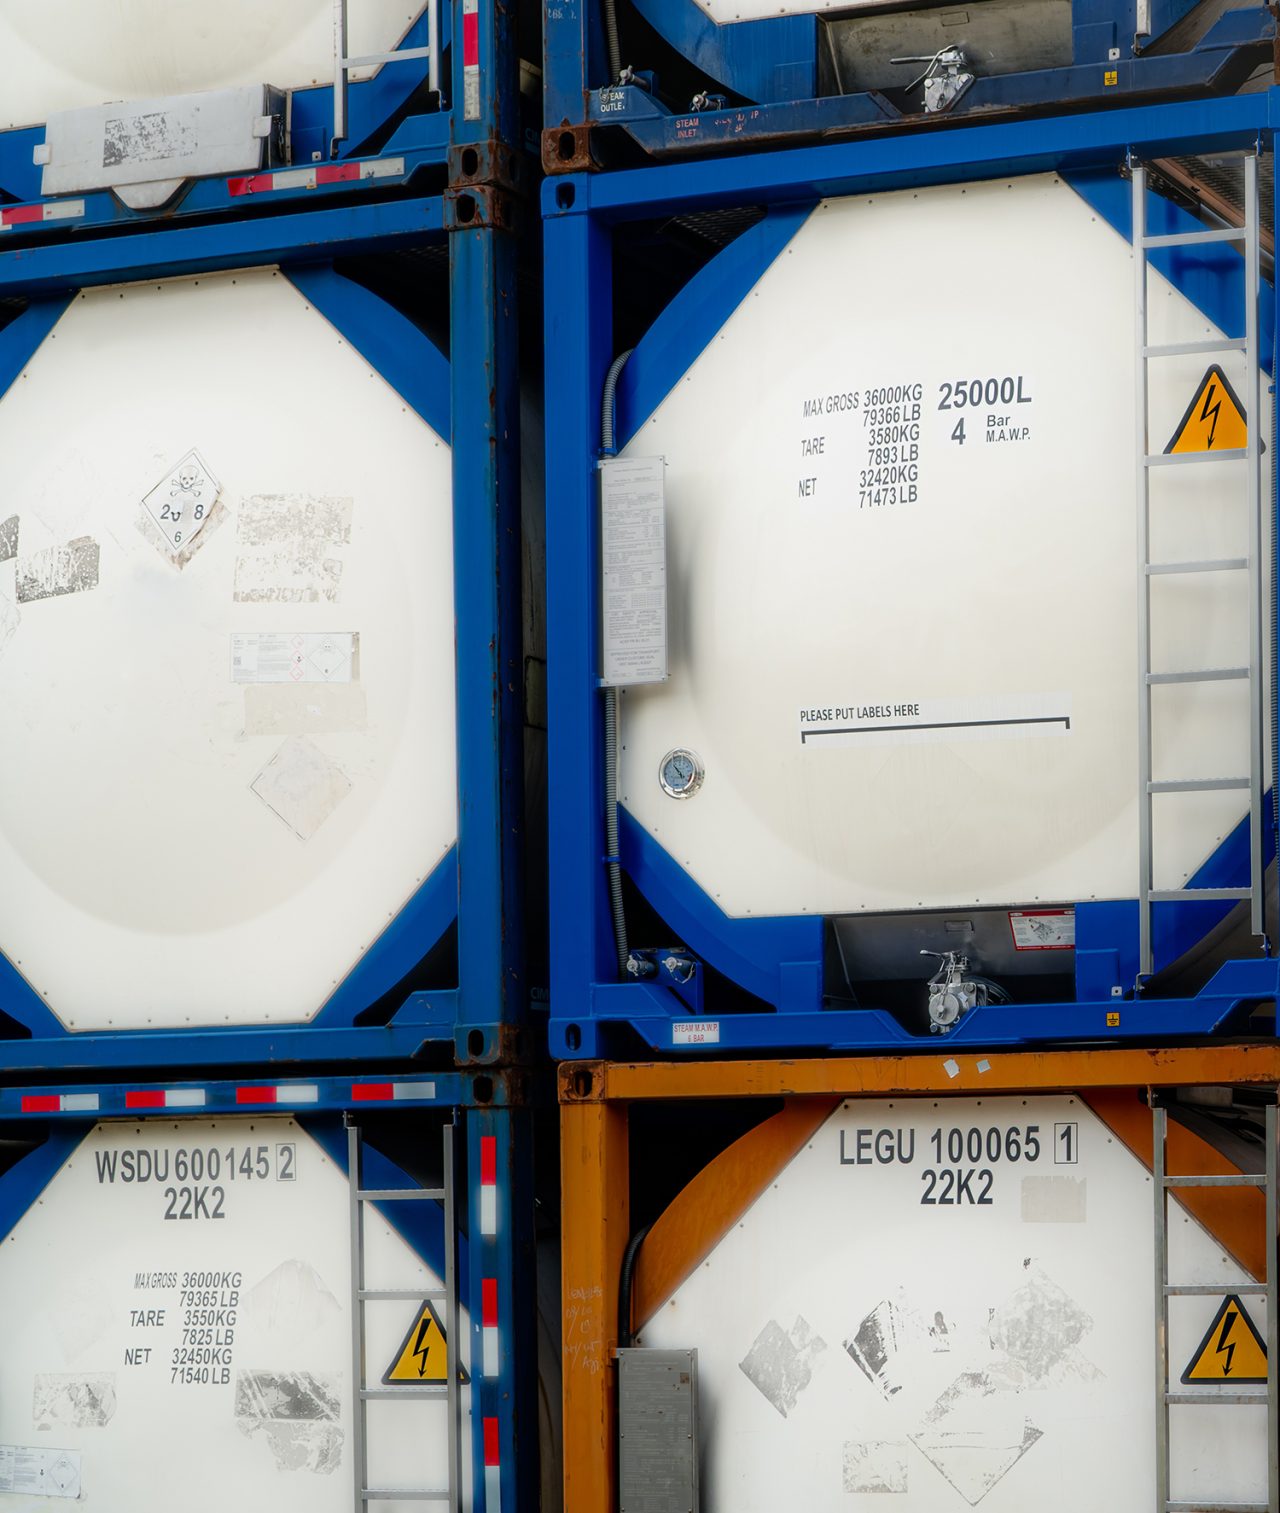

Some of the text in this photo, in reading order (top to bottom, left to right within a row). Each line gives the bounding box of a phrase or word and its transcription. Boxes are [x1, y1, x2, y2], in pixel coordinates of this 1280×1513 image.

[675, 118, 699, 129] STEAM
[677, 129, 697, 139] INLET
[803, 383, 923, 417] MAX GROSS 36000KG
[937, 375, 1032, 411] 25000L
[863, 403, 921, 427] 79366 LB
[950, 414, 1011, 446] 4 Bar
[800, 422, 920, 457] TARE 3580KG
[986, 427, 1031, 443] M.A.W.P.
[867, 443, 919, 467] 7893 LB
[798, 463, 919, 497] NET 32420KG
[858, 484, 918, 509] 71473 LB
[174, 531, 182, 543] 6
[800, 703, 920, 722] PLEASE PUT LABELS HERE
[674, 1024, 694, 1033] STEAM
[693, 1034, 705, 1042] BAR
[839, 1124, 1073, 1165] LEGU 100065 1
[1060, 1125, 1072, 1162] 1
[94, 1145, 295, 1184] WSDU 600145 2
[279, 1145, 296, 1180] 2
[151, 1272, 178, 1289] GROSS
[179, 1271, 242, 1308] 36000KG 79365
[130, 1290, 240, 1327] LB TARE
[182, 1309, 237, 1346] 3550KG 7825
[124, 1328, 234, 1366] LB NET
[170, 1366, 231, 1385] 71540 LB
